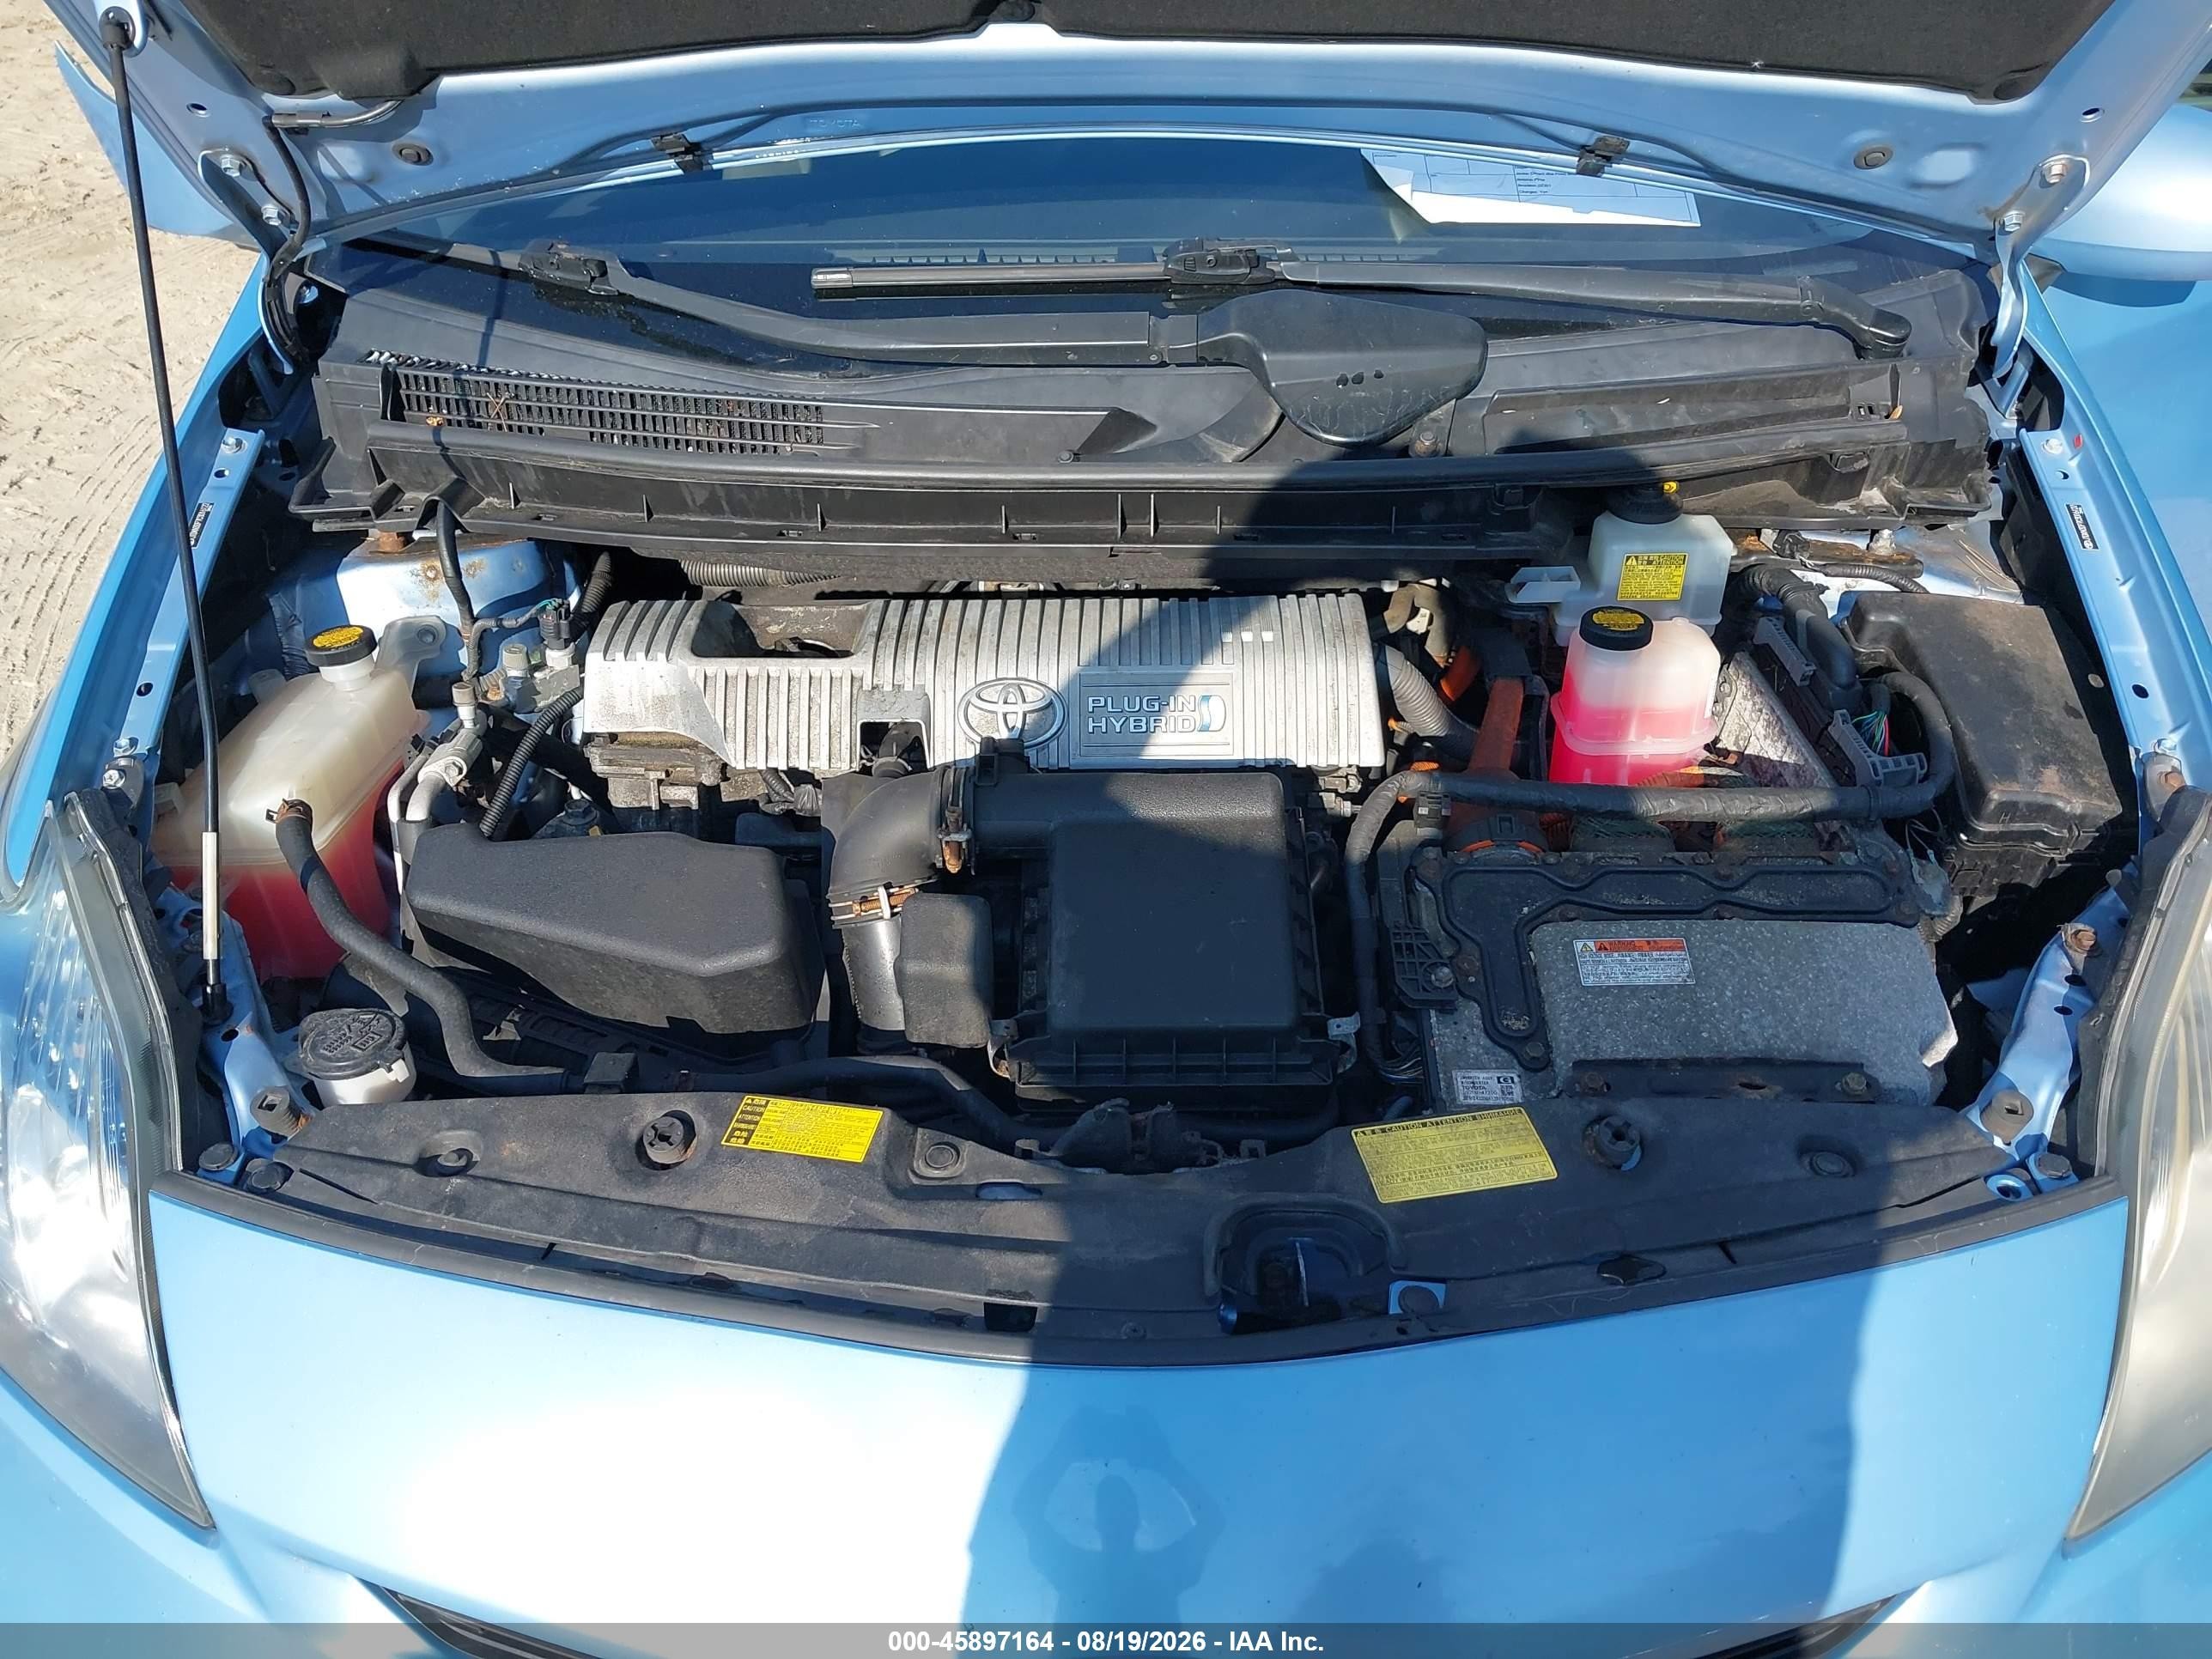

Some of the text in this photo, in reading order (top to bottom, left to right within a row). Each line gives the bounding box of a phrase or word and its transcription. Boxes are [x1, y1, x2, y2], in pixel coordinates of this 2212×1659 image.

[1087, 695, 1196, 713] PLUG-IN
[1087, 715, 1196, 733] HYBRID
[742, 1104, 766, 1113] CAUTION
[1385, 1121, 1423, 1133] CAUTION
[1426, 1115, 1473, 1127] ATTENTION
